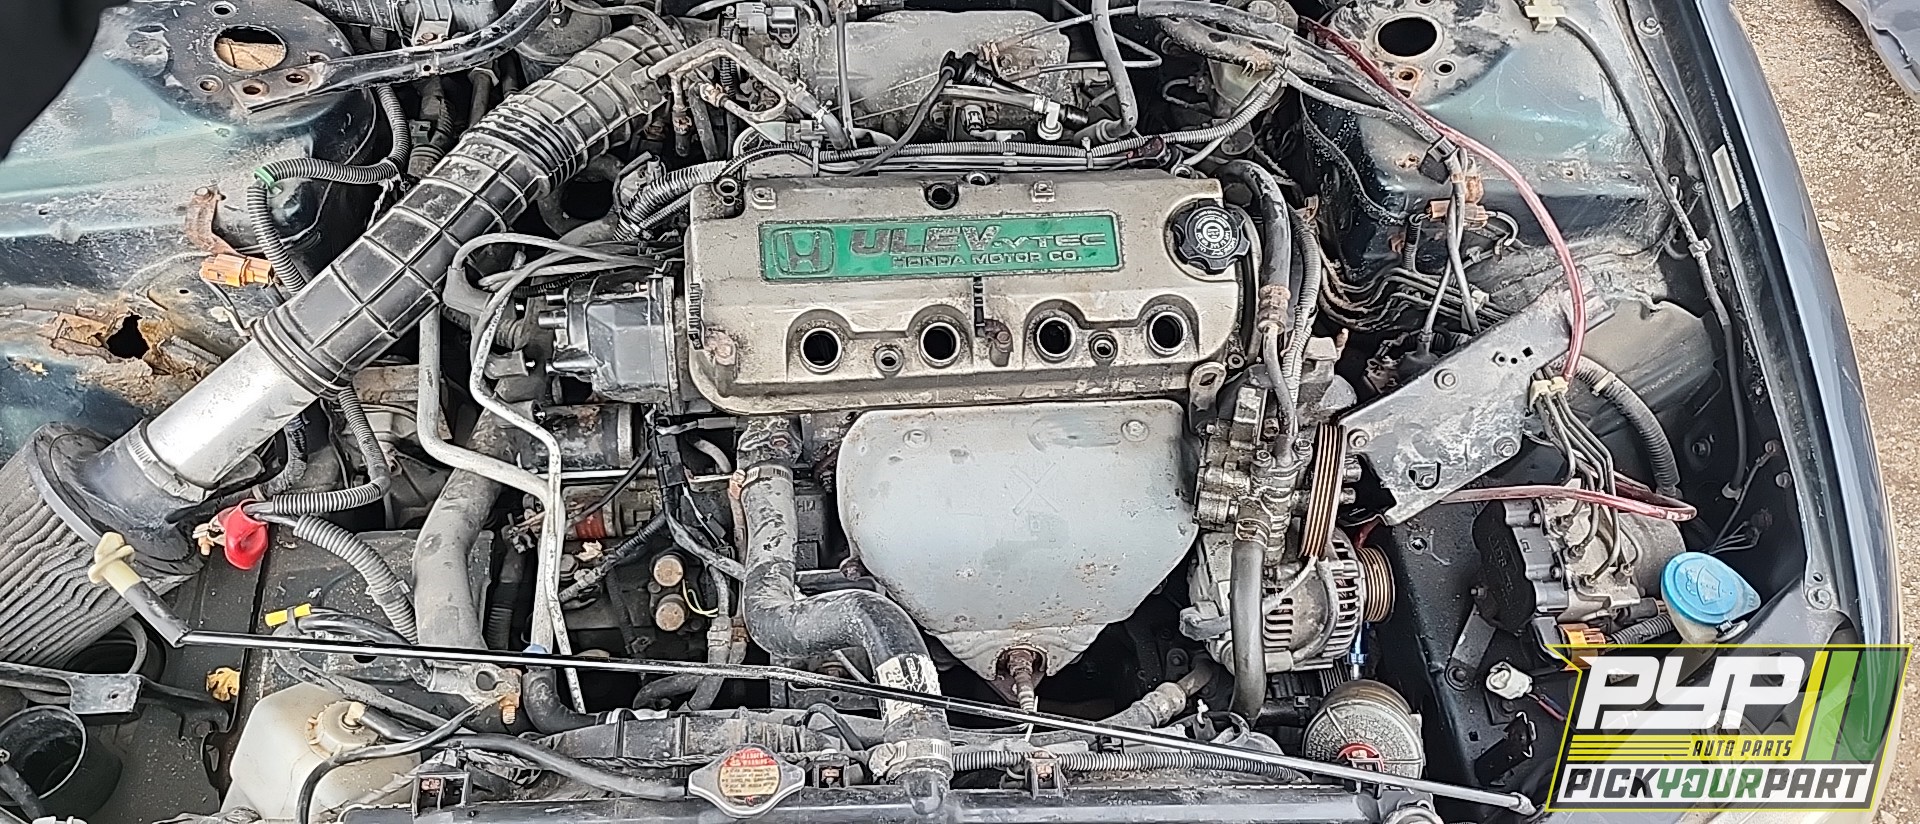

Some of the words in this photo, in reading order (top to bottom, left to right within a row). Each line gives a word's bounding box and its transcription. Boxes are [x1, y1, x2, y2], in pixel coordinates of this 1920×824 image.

[850, 224, 1000, 256] ULEV
[892, 254, 966, 269] HONDA
[970, 252, 1043, 265] MOTOR
[1048, 250, 1083, 262] CO.
